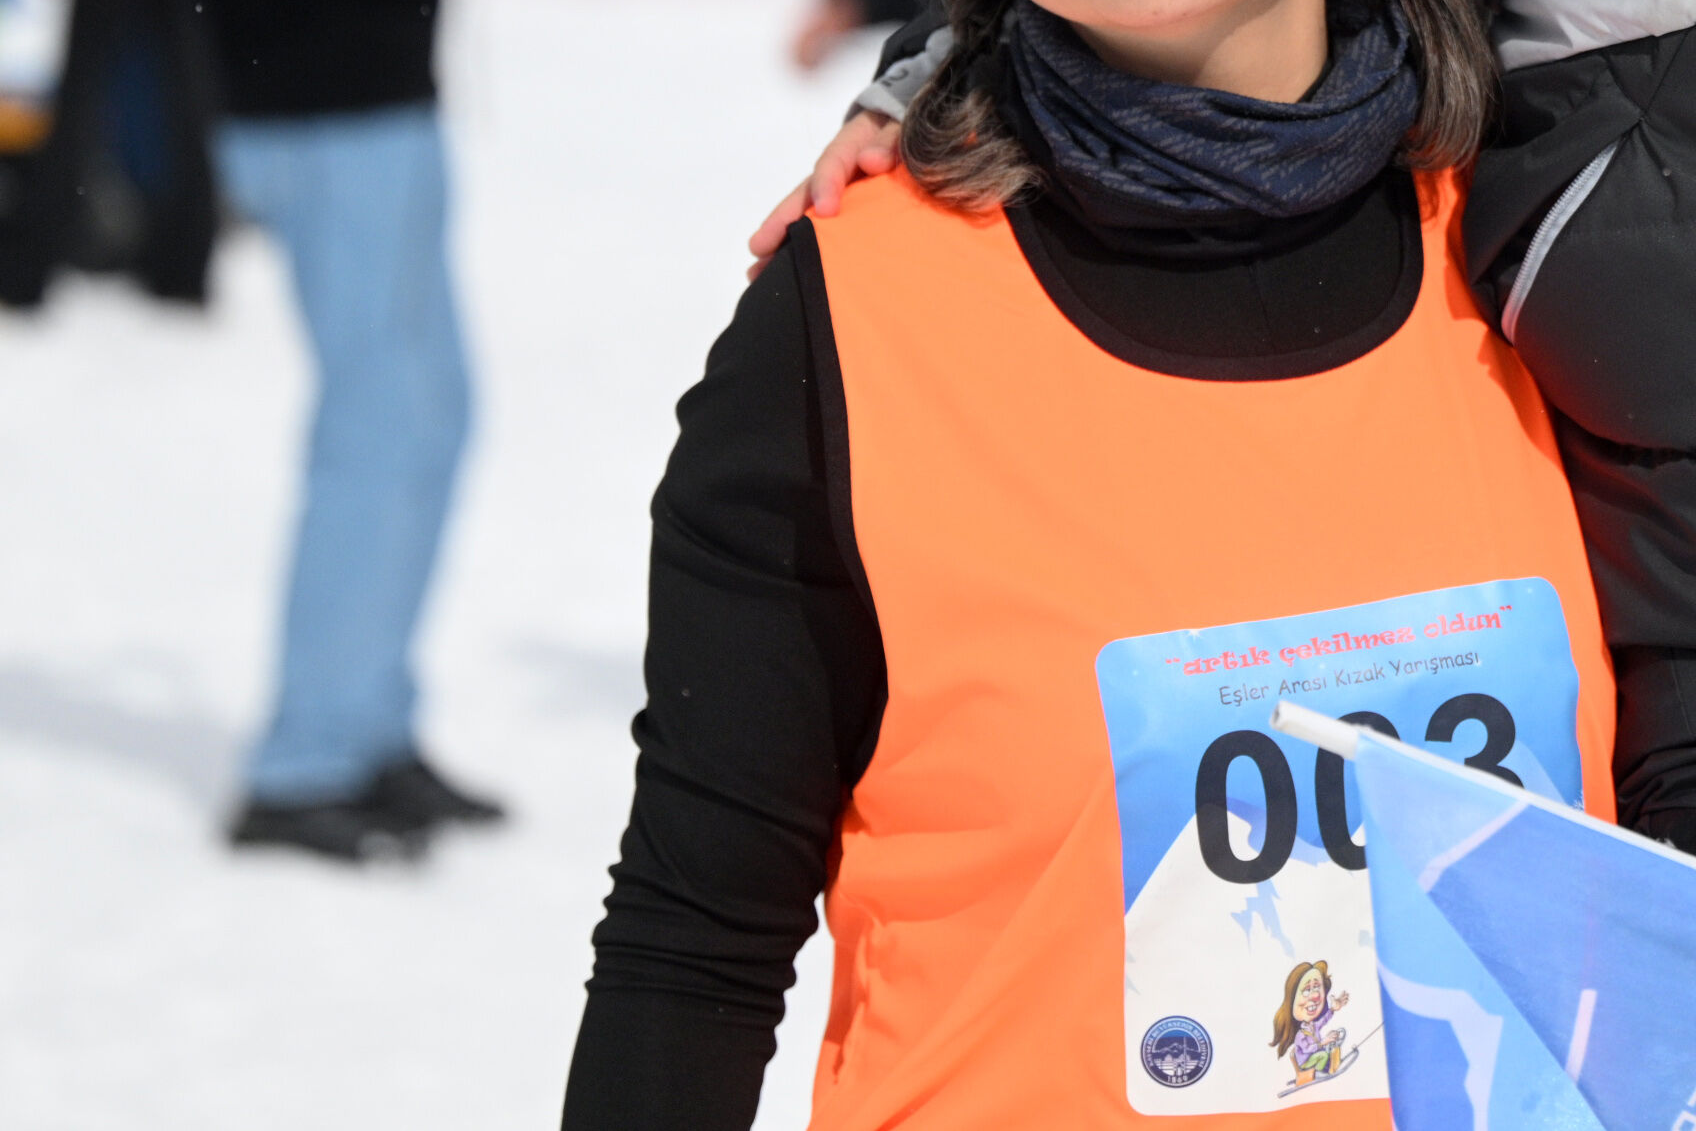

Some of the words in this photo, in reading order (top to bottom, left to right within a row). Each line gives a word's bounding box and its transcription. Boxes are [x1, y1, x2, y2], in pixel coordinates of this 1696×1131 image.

[1279, 631, 1416, 668] çekilmez
[1218, 683, 1270, 707] Eşler
[1278, 677, 1328, 696] Arası
[1334, 662, 1387, 688] Kızak
[1388, 651, 1480, 675] Yarışması
